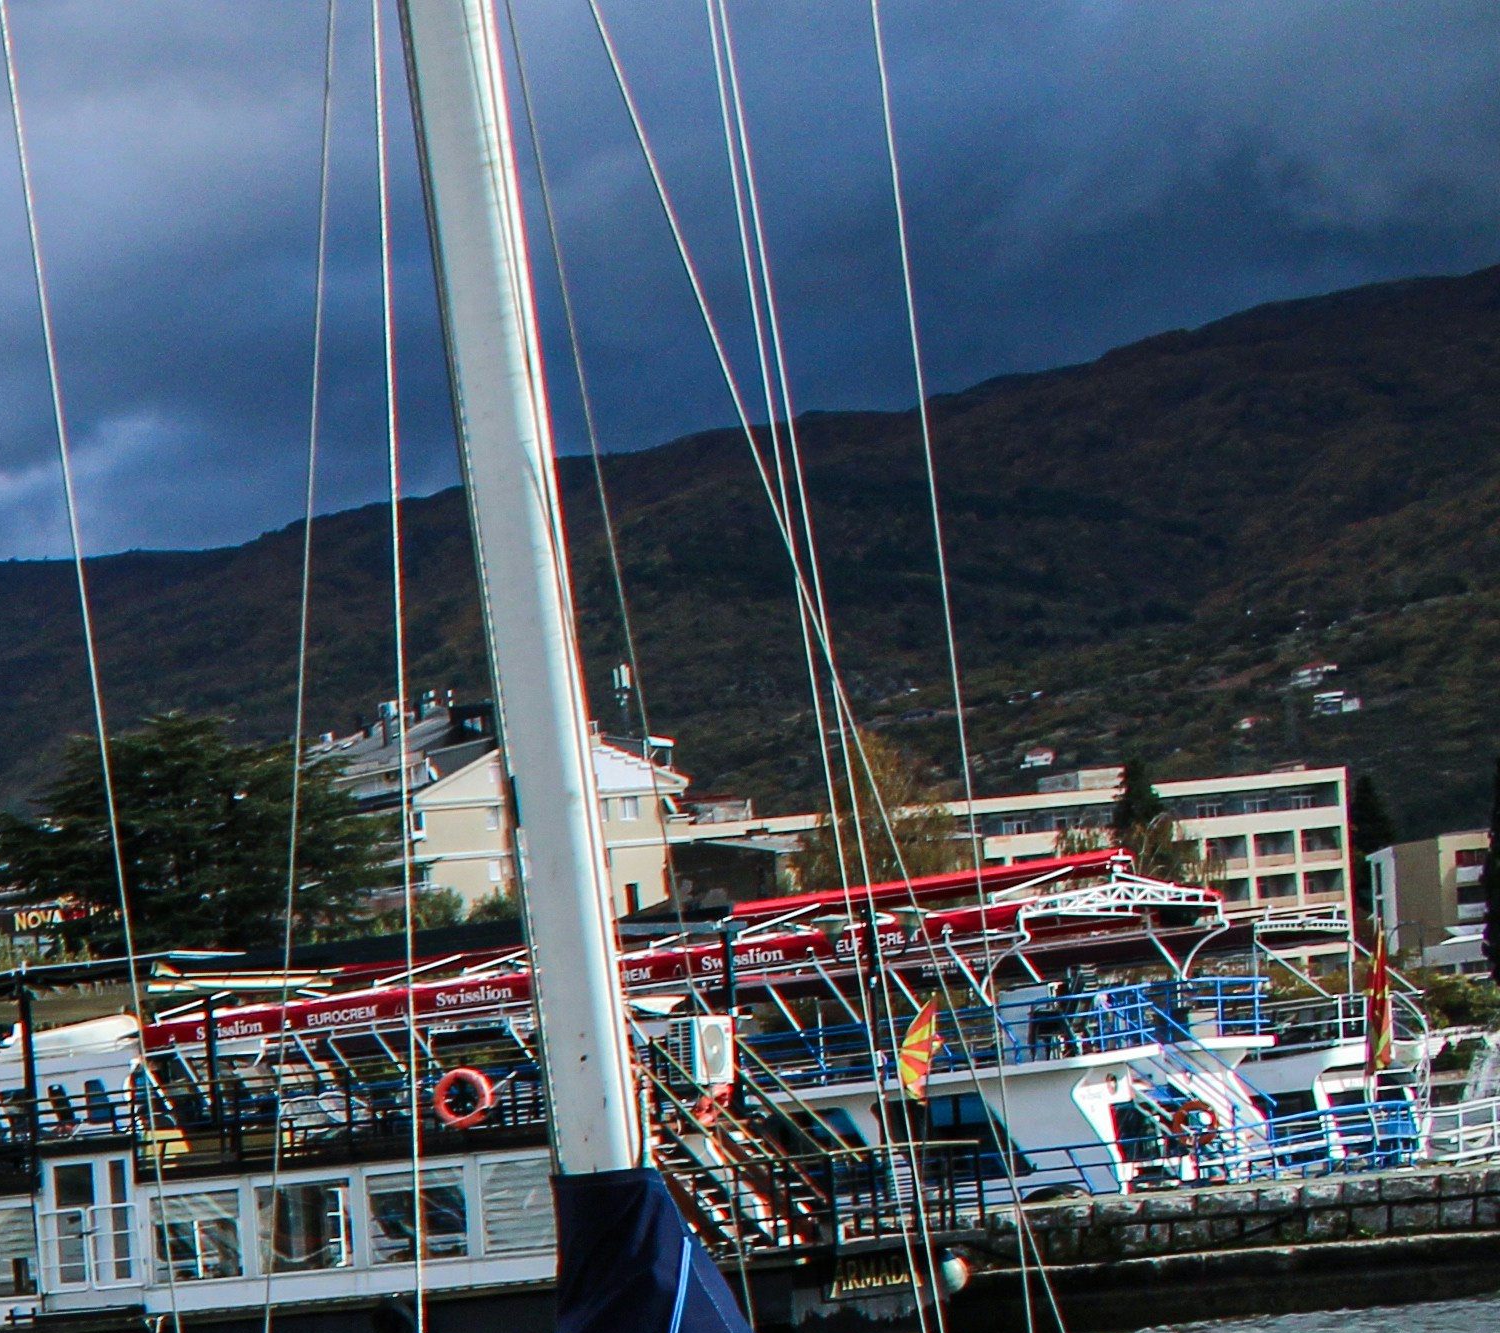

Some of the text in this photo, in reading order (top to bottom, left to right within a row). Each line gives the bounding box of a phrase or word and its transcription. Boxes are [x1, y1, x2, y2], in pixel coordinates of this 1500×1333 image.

[13, 909, 67, 932] NOVA
[701, 948, 784, 971] Swsslion
[435, 984, 513, 1007] Swisslion
[306, 1004, 378, 1027] EUROCREM
[196, 1019, 264, 1041] Sisslion
